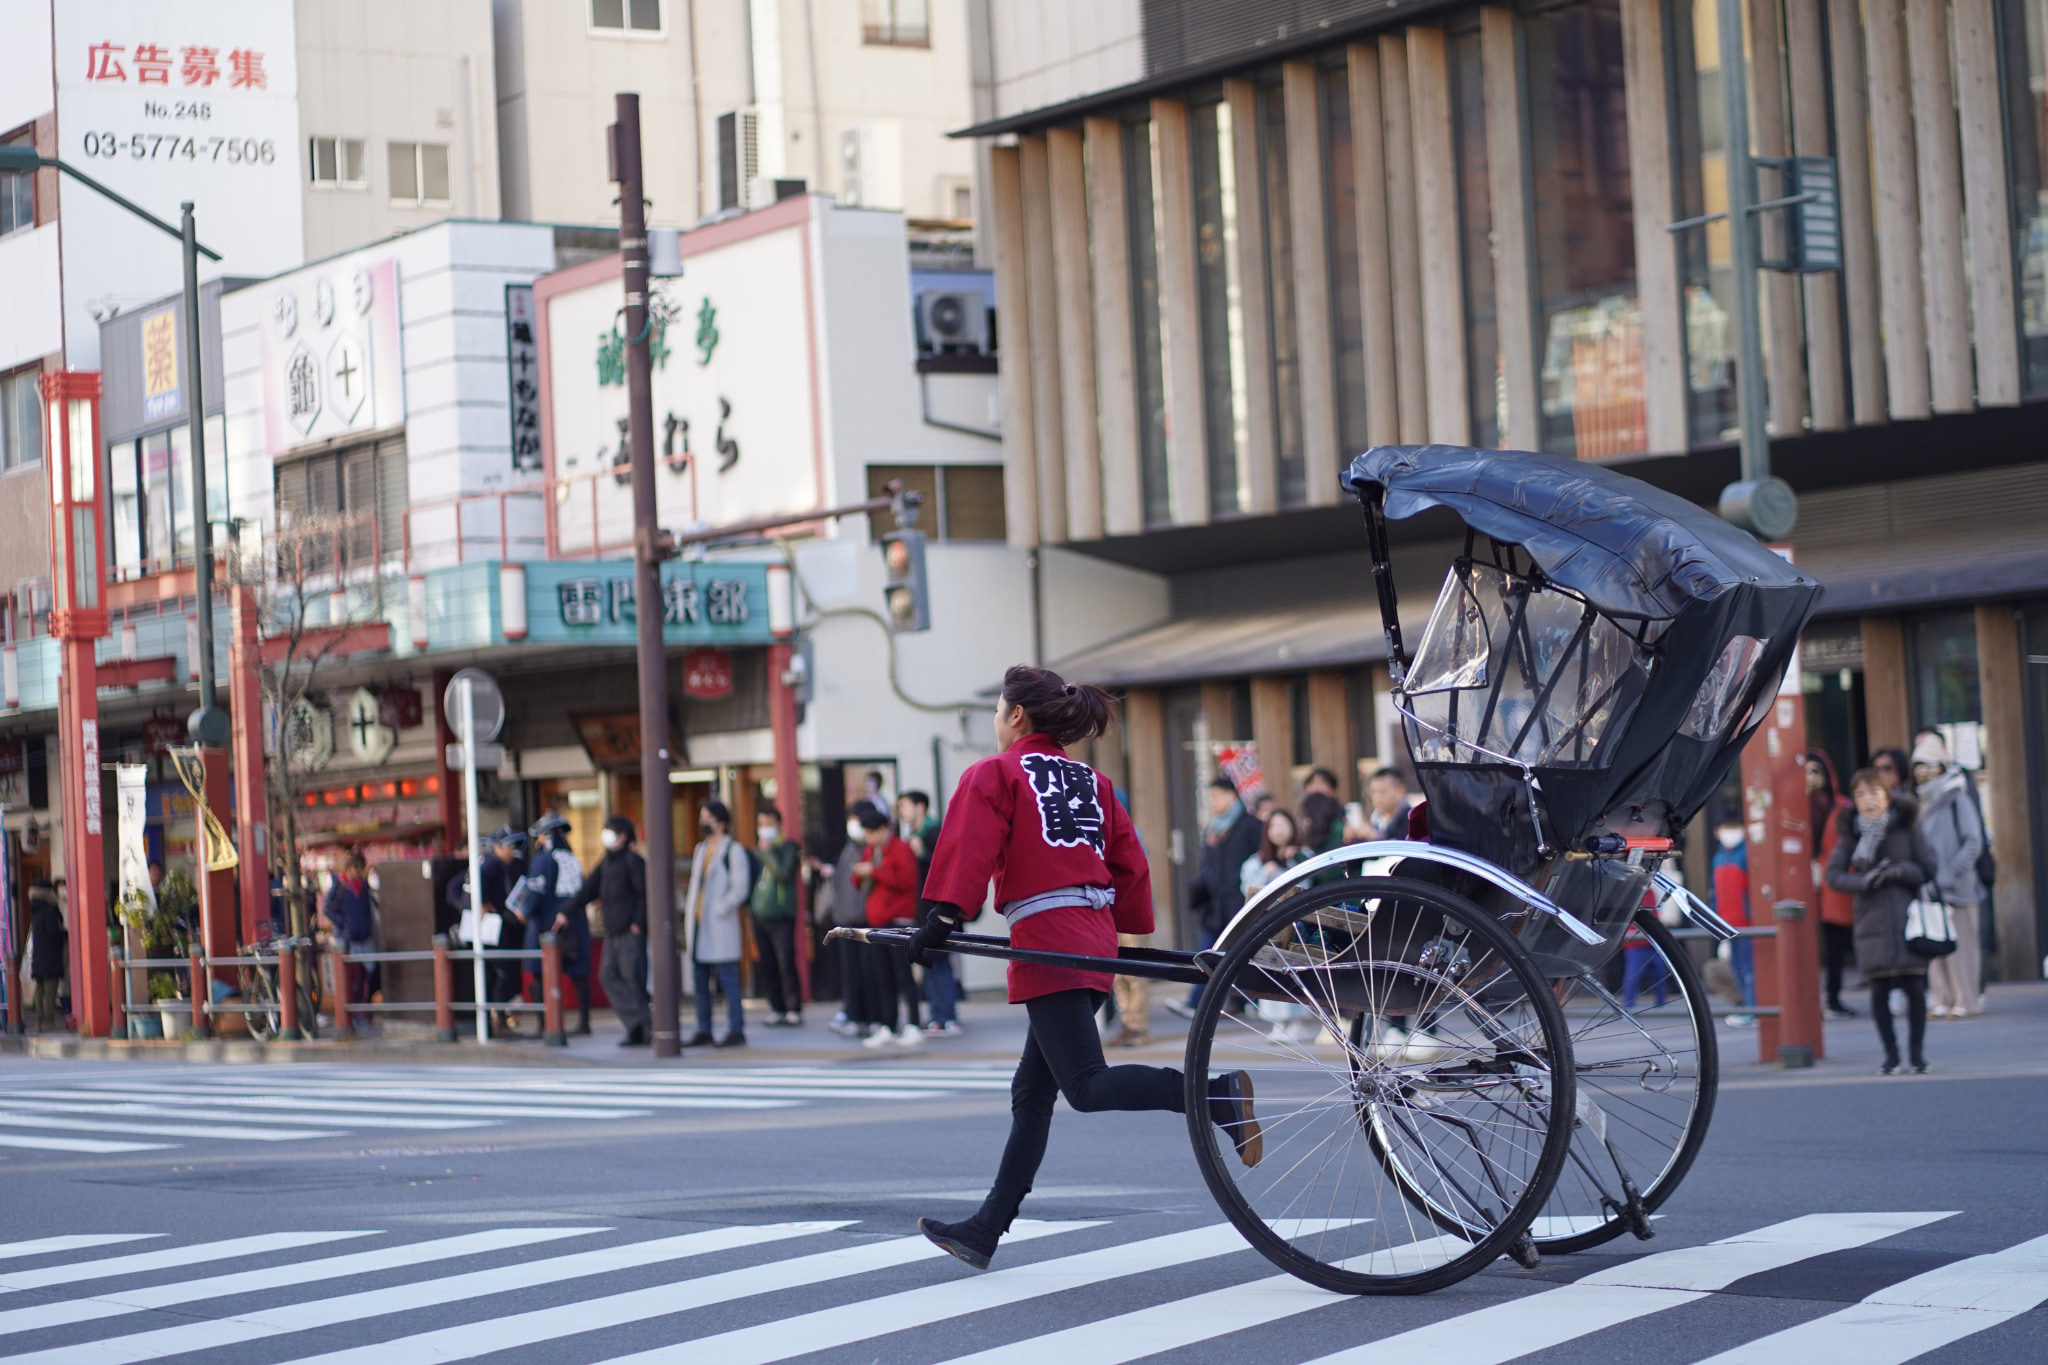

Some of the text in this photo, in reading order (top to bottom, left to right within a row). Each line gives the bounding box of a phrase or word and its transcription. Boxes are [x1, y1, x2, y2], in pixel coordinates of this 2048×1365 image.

[86, 41, 268, 90] 広告募集
[84, 131, 275, 164] 03-5774-7506
[147, 314, 173, 393] 薬
[558, 578, 749, 626] 雷門東部
